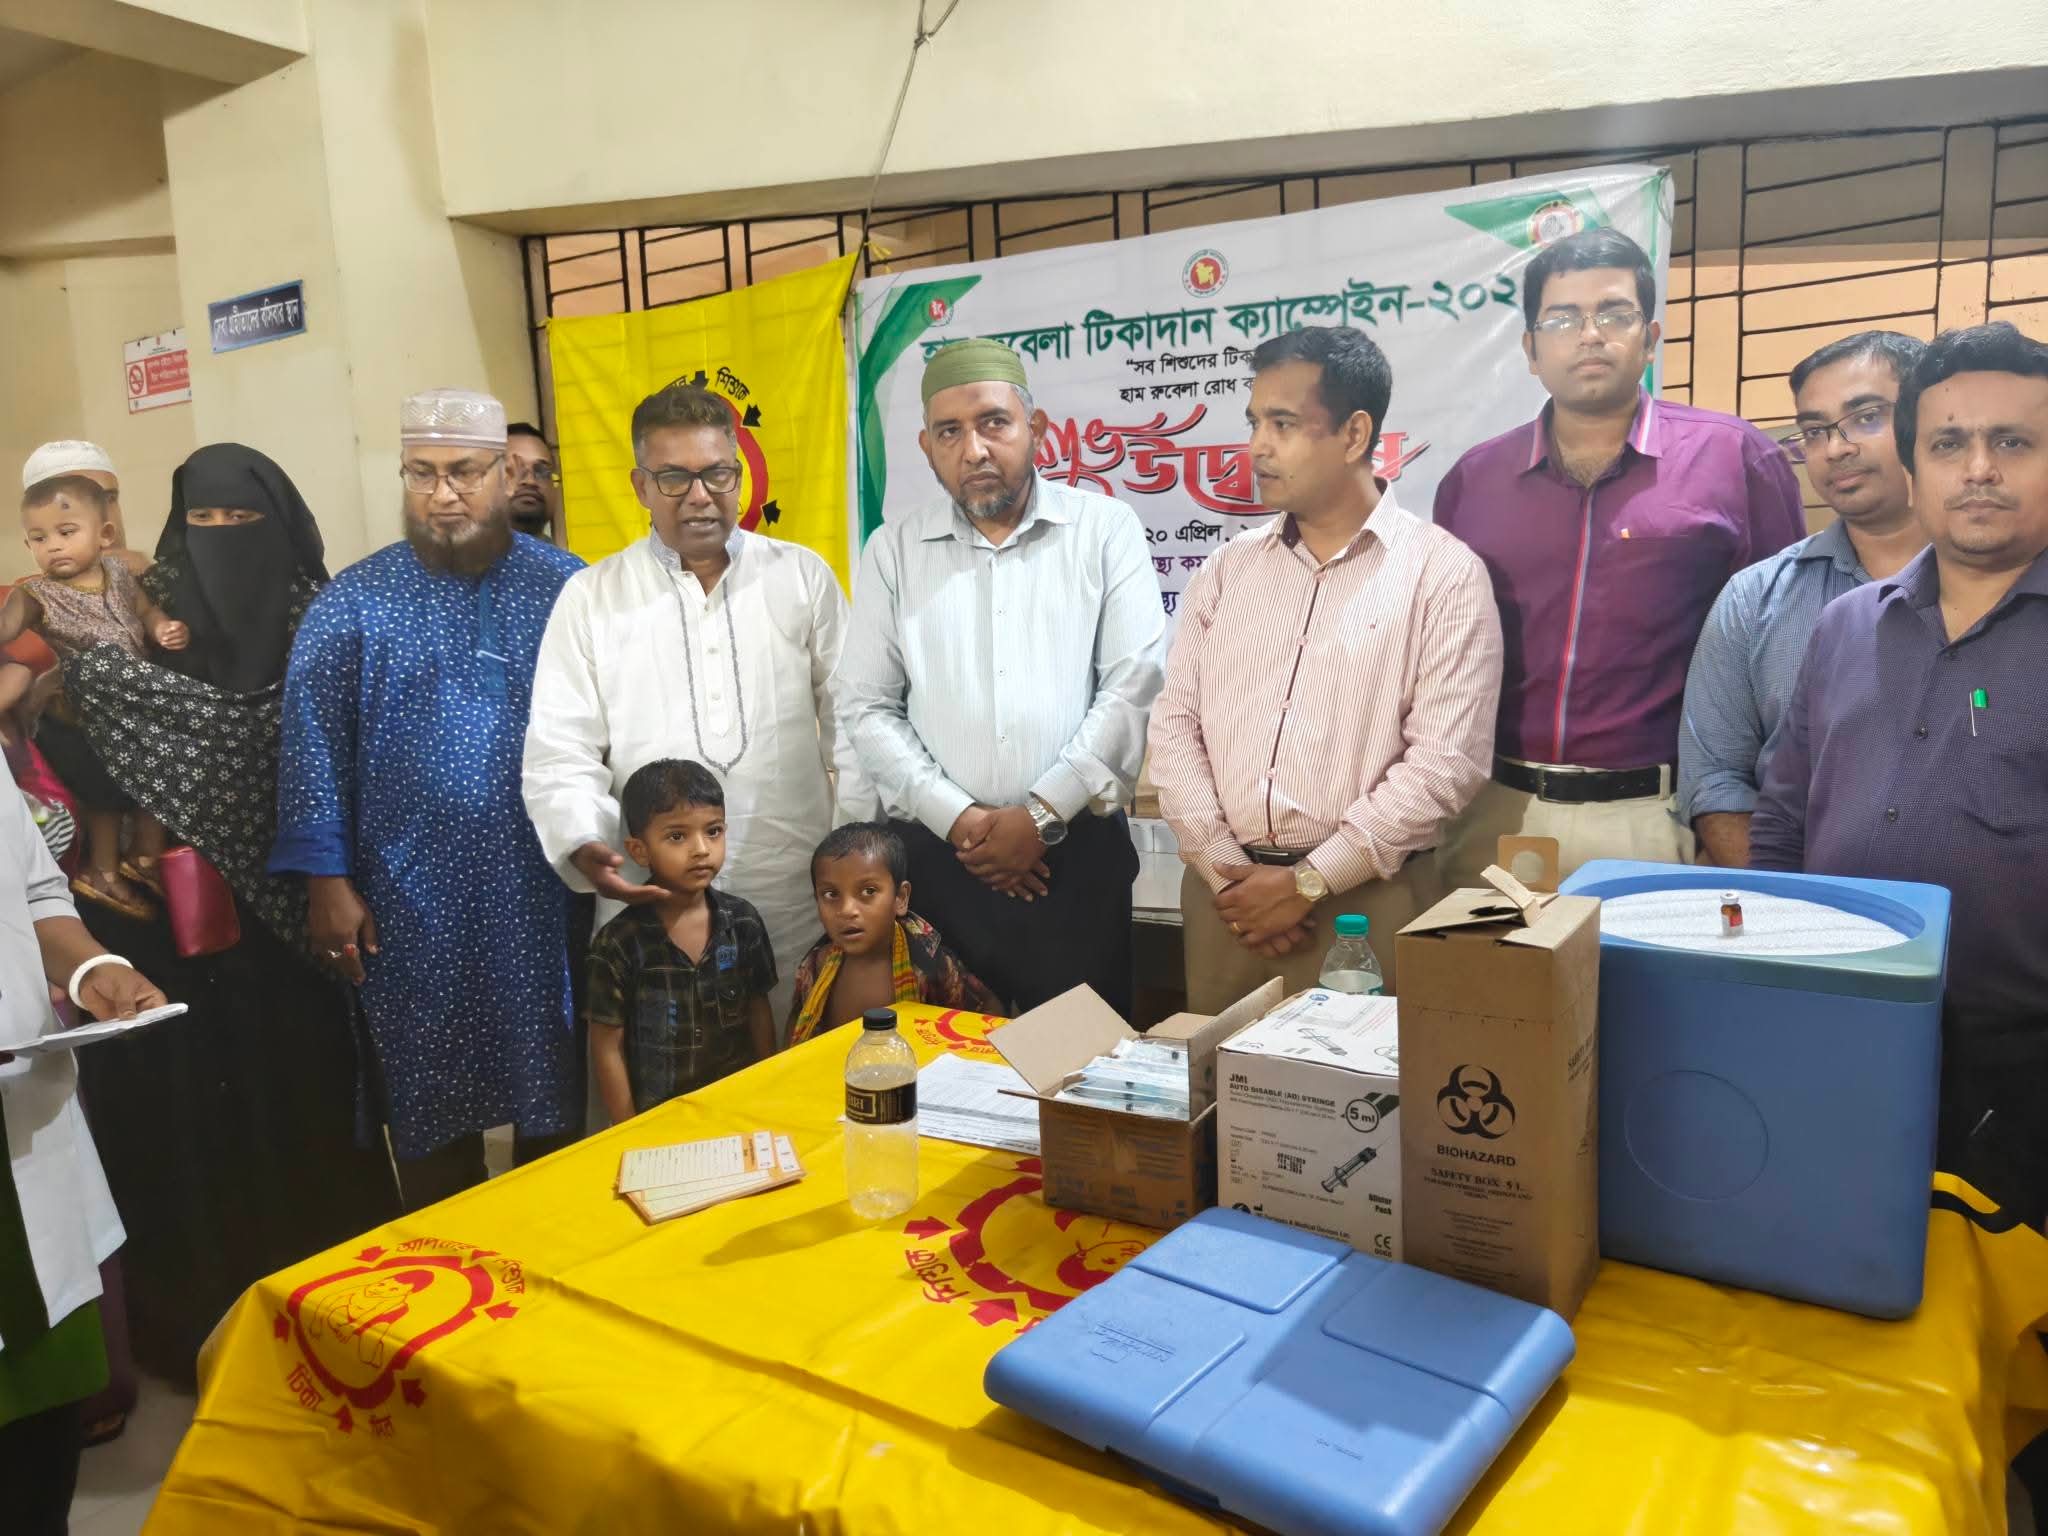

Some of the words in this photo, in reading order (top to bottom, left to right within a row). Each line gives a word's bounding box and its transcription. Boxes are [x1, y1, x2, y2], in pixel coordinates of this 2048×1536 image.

[1082, 307, 1217, 352] টিকাদান
[1224, 272, 1520, 340] ক্যাম্পেইন-২০২
[1159, 351, 1217, 374] শিশুদের
[1222, 345, 1254, 367] টিক
[1119, 386, 1144, 403] হাম
[1150, 379, 1198, 401] রুবেলা
[1203, 376, 1236, 396] রোধ
[1229, 1073, 1248, 1085] JMI
[1229, 1083, 1250, 1093] AUTO
[1251, 1086, 1283, 1098] DISABLE
[1302, 1095, 1336, 1108] SYRINGE
[1349, 1107, 1360, 1122] 5
[1361, 1113, 1376, 1124] ml
[1436, 1143, 1517, 1168] BIOHAZARD
[1431, 1167, 1473, 1183] SAFETY
[1374, 1204, 1393, 1216] Pack
[1374, 1233, 1393, 1249] CE
